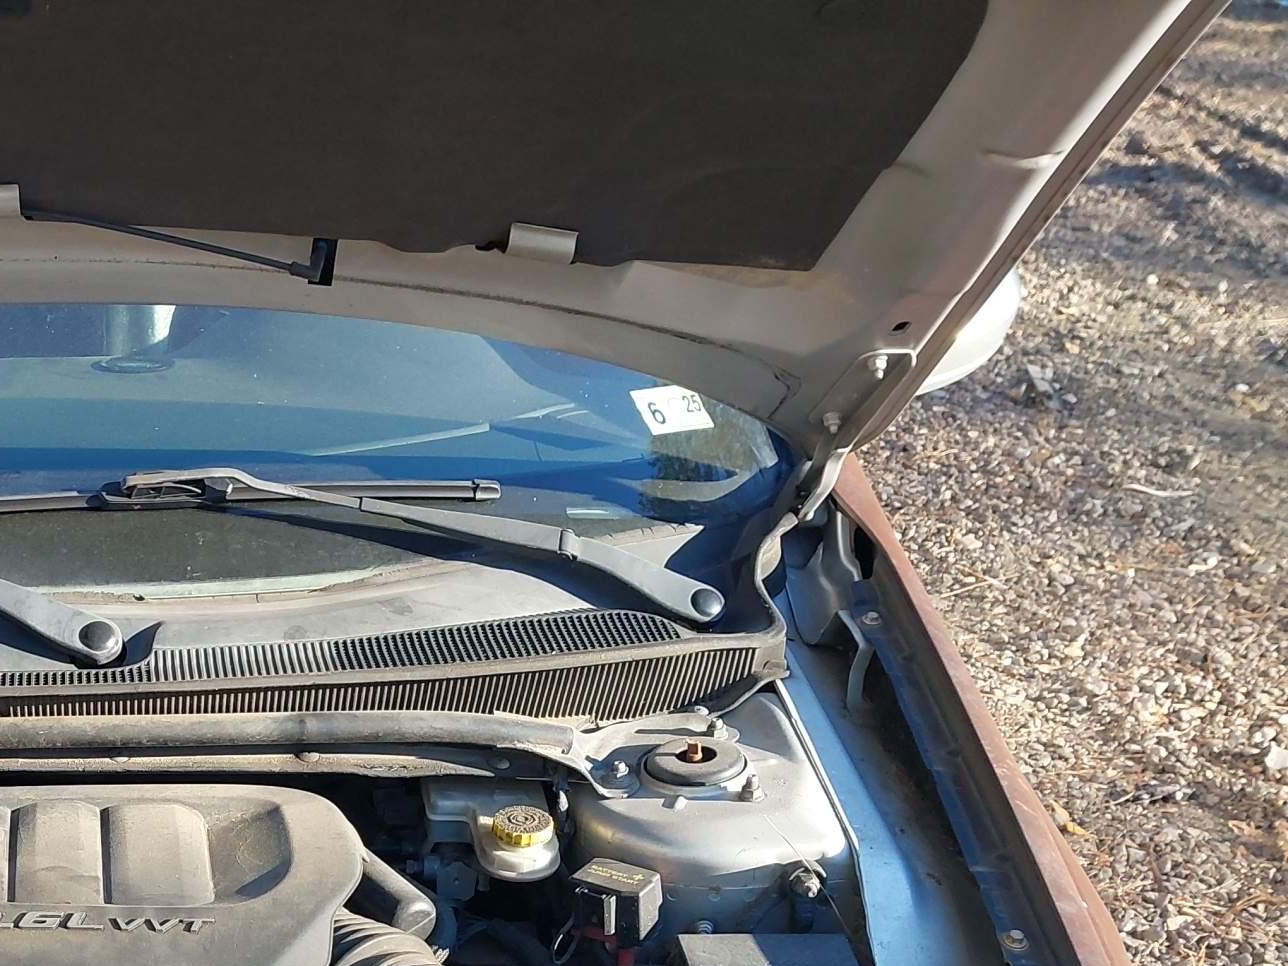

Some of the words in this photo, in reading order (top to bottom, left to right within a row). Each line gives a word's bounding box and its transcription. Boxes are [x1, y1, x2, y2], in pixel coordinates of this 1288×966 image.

[682, 394, 701, 412] 25
[647, 402, 666, 424] 6
[108, 917, 216, 934] VVT
